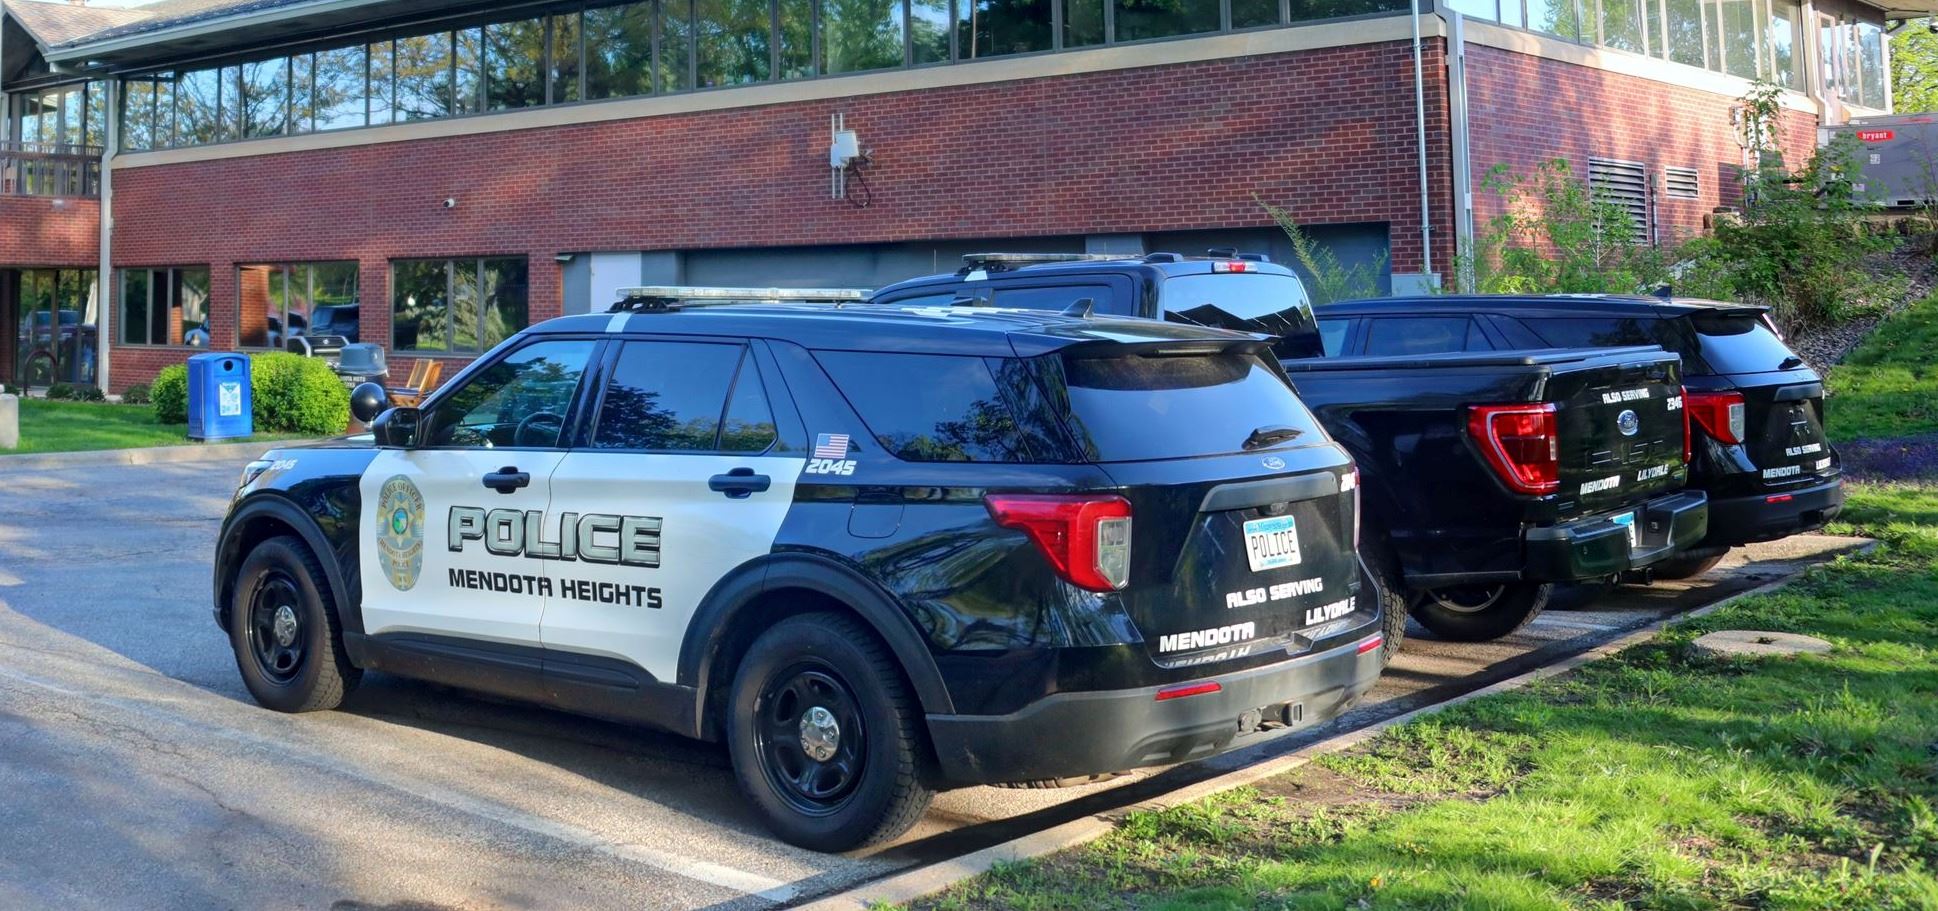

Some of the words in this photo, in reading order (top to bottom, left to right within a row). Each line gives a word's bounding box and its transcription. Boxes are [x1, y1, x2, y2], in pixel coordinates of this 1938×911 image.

[1862, 131, 1888, 141] bryant
[1602, 391, 1622, 404] ALSO
[1622, 387, 1650, 402] SERVING
[805, 458, 857, 476] 2045
[1637, 463, 1670, 482] LILYDALE
[1763, 464, 1801, 479] MENDOTA
[1579, 474, 1621, 496] MENDOTA
[447, 505, 664, 569] POLICE
[1250, 530, 1296, 560] POLICE
[448, 567, 553, 597] MENDOTA
[560, 578, 663, 609] HEIGHTS
[1225, 587, 1267, 608] ALSO
[1269, 577, 1323, 600] SERVING
[1305, 596, 1356, 626] LILYDALE
[1159, 621, 1255, 652] MENDOTA
